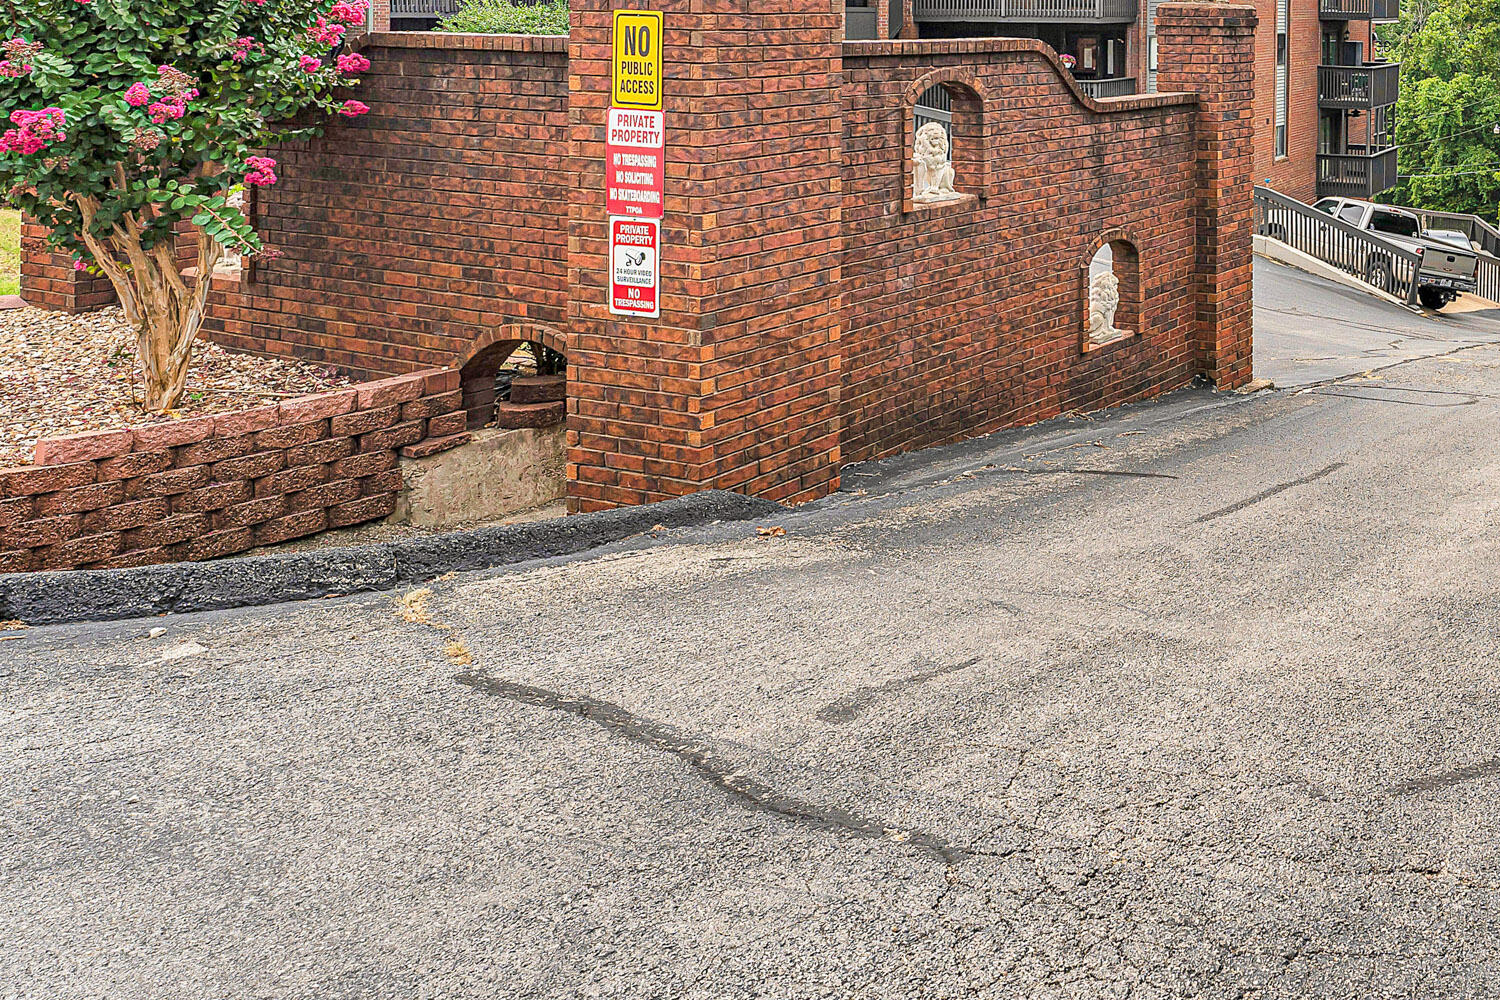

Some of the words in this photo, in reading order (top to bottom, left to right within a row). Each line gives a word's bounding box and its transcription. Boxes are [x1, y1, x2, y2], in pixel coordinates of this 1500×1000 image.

[625, 25, 650, 57] NO
[621, 61, 653, 76] PUBLIC
[620, 79, 654, 95] ACCESS
[617, 114, 655, 129] PRIVATE
[611, 129, 660, 144] PROPERTY
[613, 153, 621, 165] NO
[622, 153, 657, 168] TRESPASSING
[615, 171, 624, 183] NO
[625, 171, 654, 185] SOLICITING
[609, 188, 617, 200] NO
[620, 224, 649, 235] PRIVATE
[615, 233, 653, 245] PROPERTY
[623, 268, 637, 276] HOUR
[637, 269, 652, 277] VIDEO
[627, 288, 641, 299] NO
[614, 297, 654, 310] TRESPASSING
